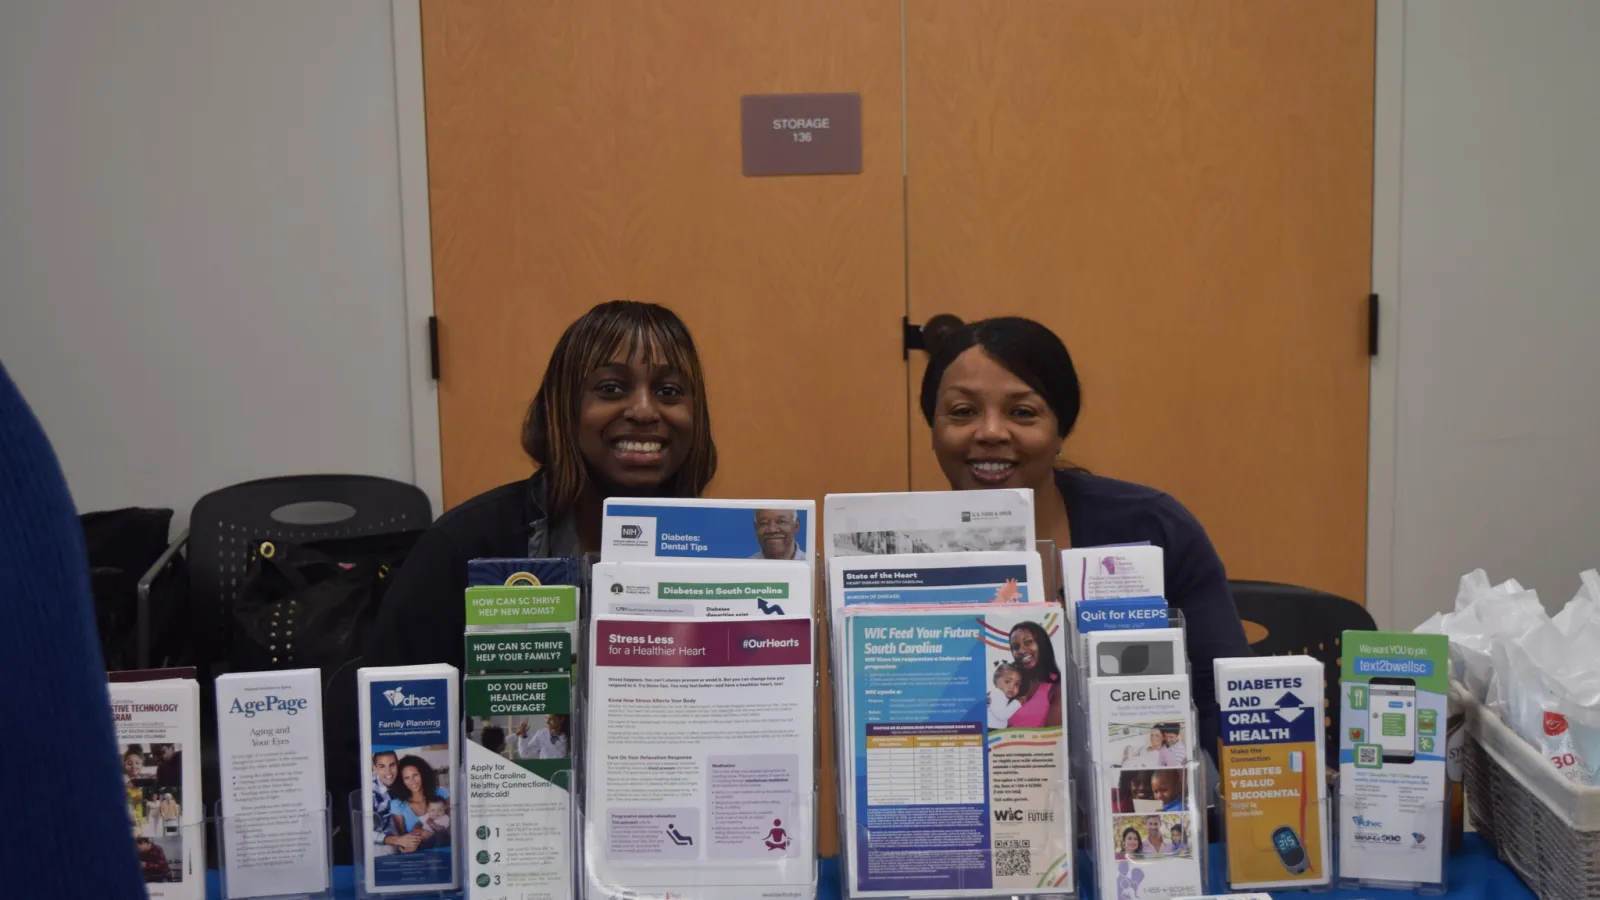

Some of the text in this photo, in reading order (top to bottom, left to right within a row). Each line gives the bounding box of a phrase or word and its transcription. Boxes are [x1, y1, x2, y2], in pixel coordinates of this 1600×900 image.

[773, 118, 830, 130] STORAGE
[793, 132, 812, 142] 136
[622, 528, 637, 536] NIH
[661, 533, 701, 542] Diabetes:
[661, 543, 708, 552] Dental Tips
[894, 571, 918, 579] Heart
[663, 586, 783, 595] Diabetes in South Carolina
[472, 596, 561, 606] HOW CAN SC THRIVE
[478, 606, 555, 617] HELP NEW MOMS?
[1081, 609, 1167, 622] Quit for KEEPS
[864, 626, 980, 640] WIC Feed Your Future
[608, 633, 675, 645] Stress Less
[742, 637, 800, 649] #OurHearts
[473, 641, 564, 651] HOW CAN SC THRIVE
[608, 645, 706, 656] for a Healthier Heart
[864, 640, 943, 655] South Carolina
[1359, 644, 1427, 657] We want YOU to join
[476, 651, 561, 662] HELP YOUR FAMILY?
[1359, 659, 1427, 673] text2bwellsc
[487, 682, 548, 692] DO YOU NEED
[1227, 678, 1303, 691] DIABETES
[490, 693, 546, 702] HEALTHCARE
[1110, 687, 1181, 702] Care Line
[402, 694, 436, 707] dhec
[1228, 697, 1261, 708] AND
[131, 703, 179, 713] TECHNOLOGY
[229, 695, 308, 718] AgePage
[490, 703, 546, 712] COVERAGE?
[378, 718, 441, 729] Family Planning
[1228, 712, 1270, 725] ORAL
[249, 725, 291, 737] Aging and
[1229, 728, 1290, 742] HEALTH
[251, 737, 290, 747] Your Eyes
[1230, 755, 1271, 763] Connection
[470, 763, 506, 773] Apply for
[1230, 766, 1282, 777] DIABETES
[470, 771, 527, 780] South Carolina
[470, 781, 500, 791] Healthy
[1230, 778, 1275, 788] Y SALUD
[470, 791, 510, 799] Medicaid!
[1231, 788, 1301, 800] BUCODENTAL
[994, 806, 1024, 822] WIC
[494, 827, 501, 838] 1
[1279, 835, 1295, 848] 215
[493, 852, 501, 863] 2
[493, 875, 502, 886] 3
